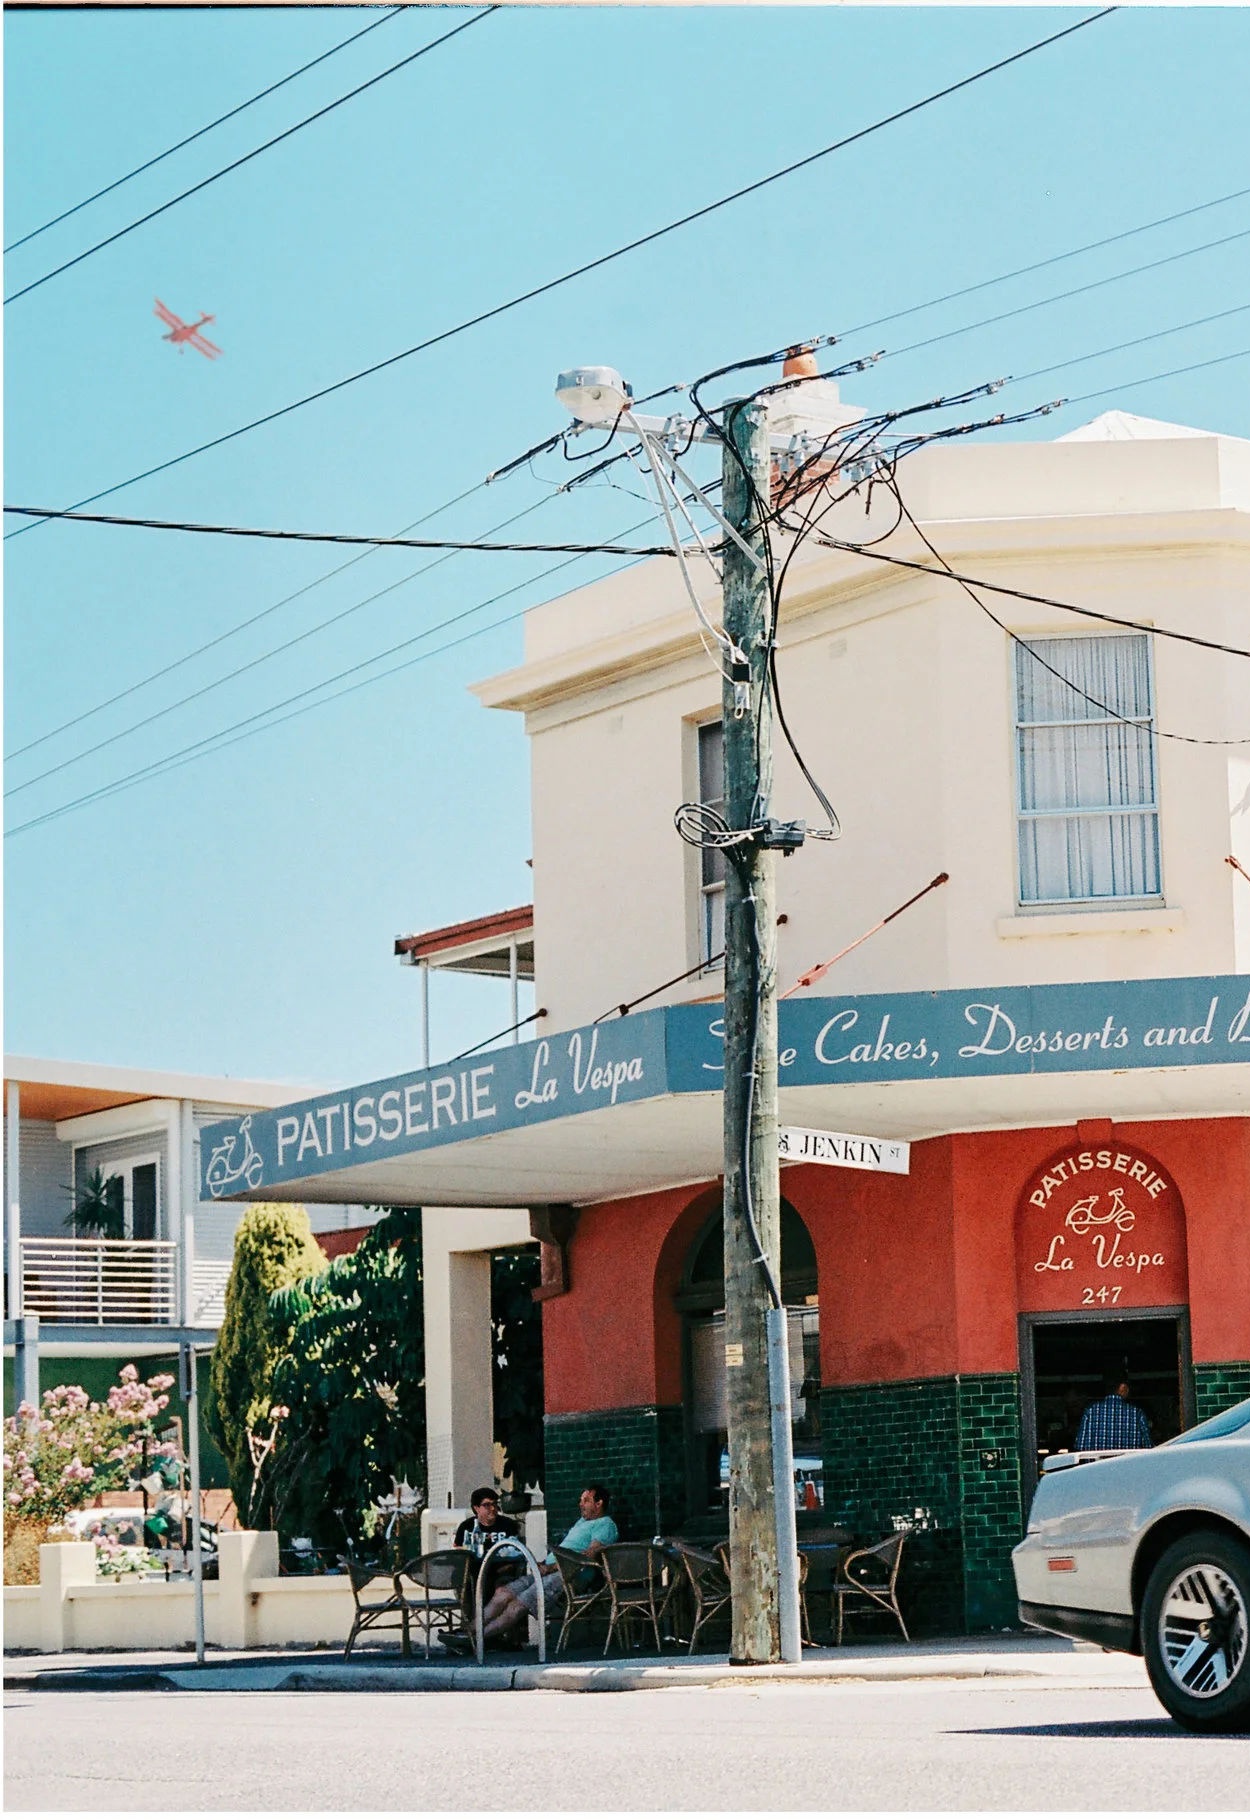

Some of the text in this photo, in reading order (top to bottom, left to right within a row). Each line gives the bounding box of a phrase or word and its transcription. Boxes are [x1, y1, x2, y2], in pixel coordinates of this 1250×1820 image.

[814, 1009, 939, 1067] Cakes,
[958, 1003, 1128, 1058] Desserts
[1143, 996, 1219, 1047] and
[277, 1063, 497, 1167] PATISSERIE
[514, 1041, 558, 1110] La
[568, 1029, 644, 1104] Vespa
[799, 1134, 901, 1165] JENKIN ST
[1028, 1150, 1168, 1209] PATISSERIE
[1033, 1233, 1165, 1274] La Vespa
[1081, 1285, 1123, 1304] 247
